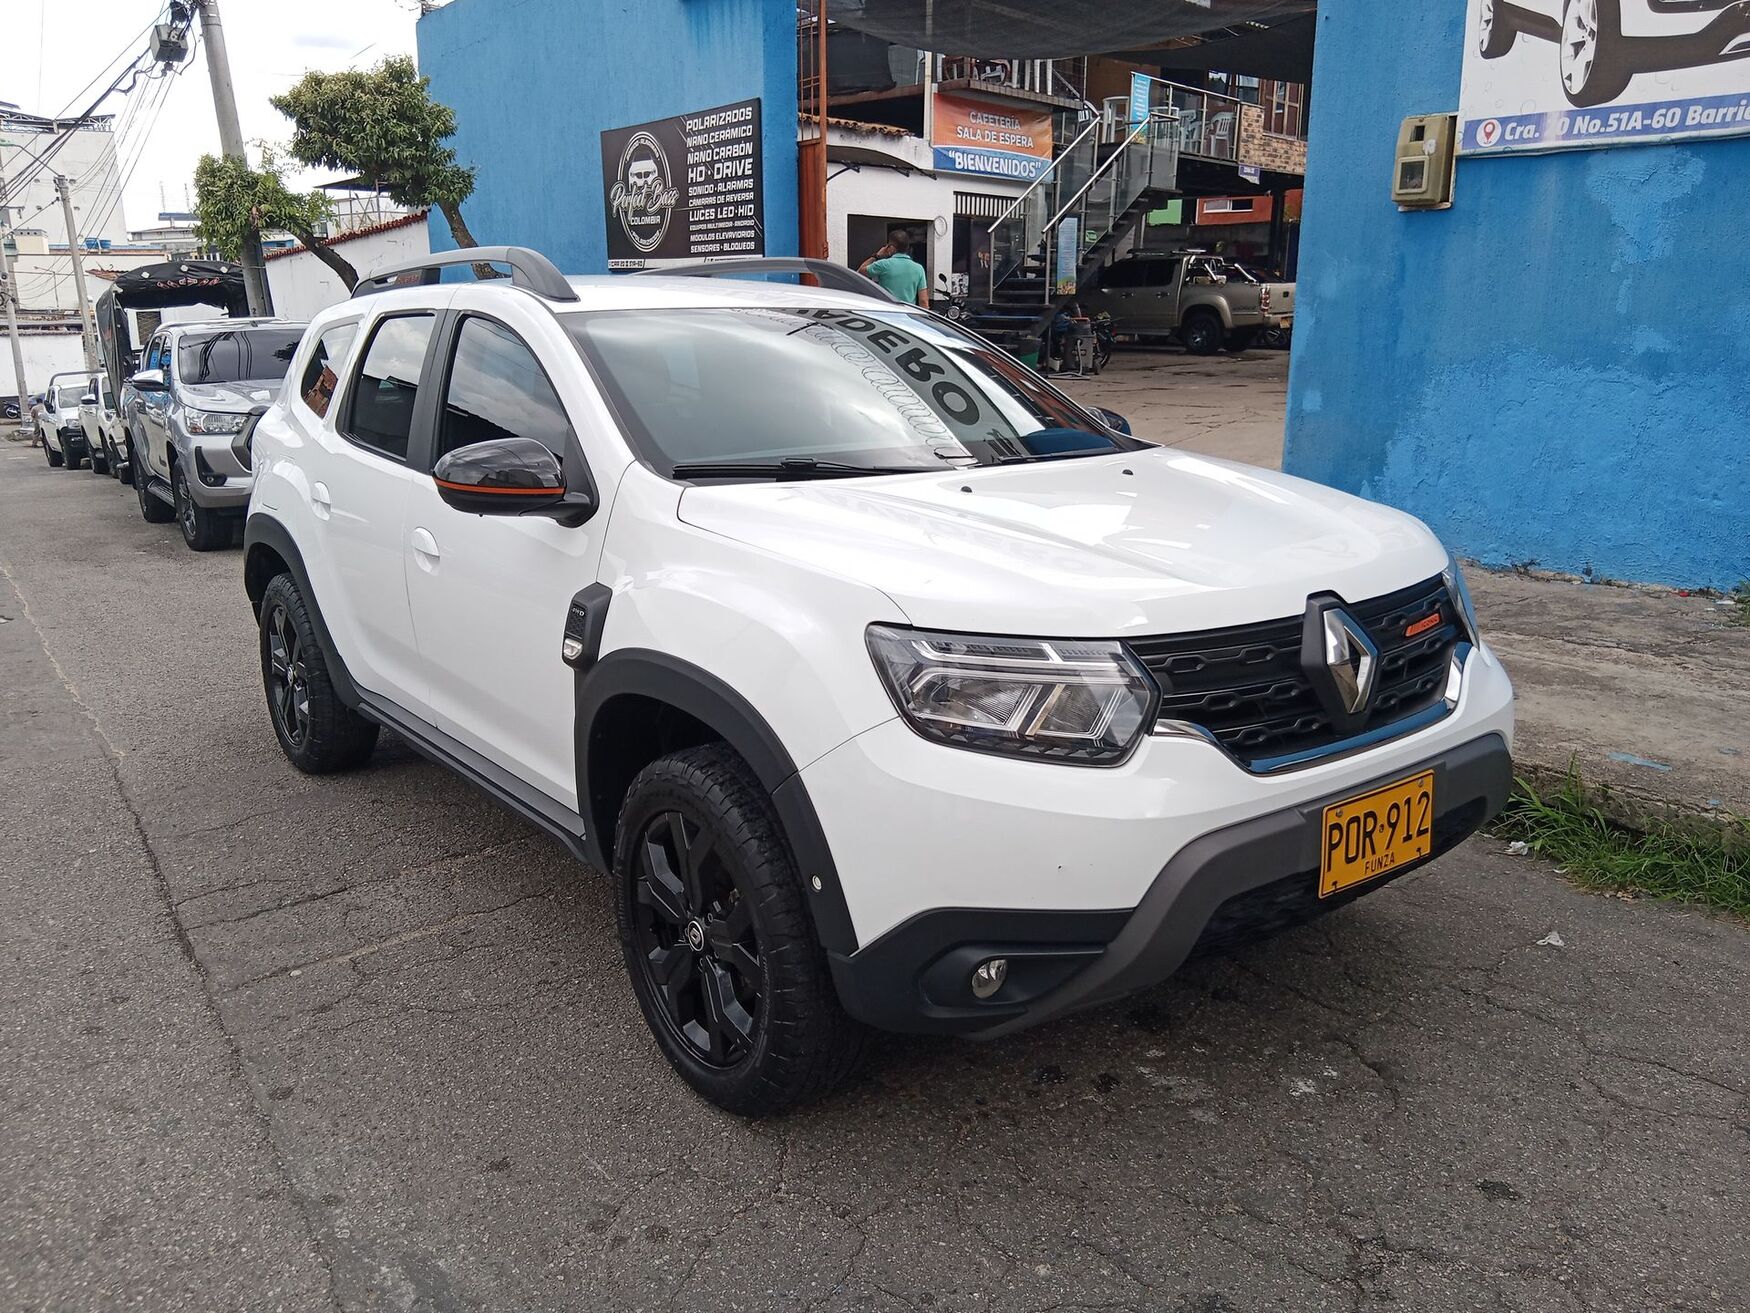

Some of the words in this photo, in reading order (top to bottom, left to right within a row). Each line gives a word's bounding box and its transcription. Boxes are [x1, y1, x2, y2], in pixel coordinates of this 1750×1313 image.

[686, 106, 753, 132] POLARIZADOS
[969, 111, 1021, 130] CAFETERÍA
[1504, 122, 1540, 141] Cra.
[1572, 107, 1681, 134] No.51A-60
[686, 133, 708, 148] NANO
[709, 125, 753, 143] CERÁMICO
[956, 126, 982, 140] SALA
[984, 130, 998, 143] DE
[999, 132, 1034, 148] ESPERA
[687, 149, 712, 165] NANO
[713, 140, 753, 160] CARBÓN
[687, 165, 706, 184] HD
[713, 158, 754, 180] DRIVE
[688, 184, 714, 196] SONIDO
[717, 178, 754, 192] ALARMAS
[716, 195, 725, 204] DE
[725, 192, 754, 203] REVERSA
[630, 215, 660, 226] COLOMBIA
[689, 208, 716, 222] LUCES
[717, 206, 735, 219] LED
[737, 204, 754, 216] HID
[690, 243, 720, 253] SENSORES
[723, 241, 755, 251] BLOQUEOS
[1364, 852, 1395, 875] FUNZA
